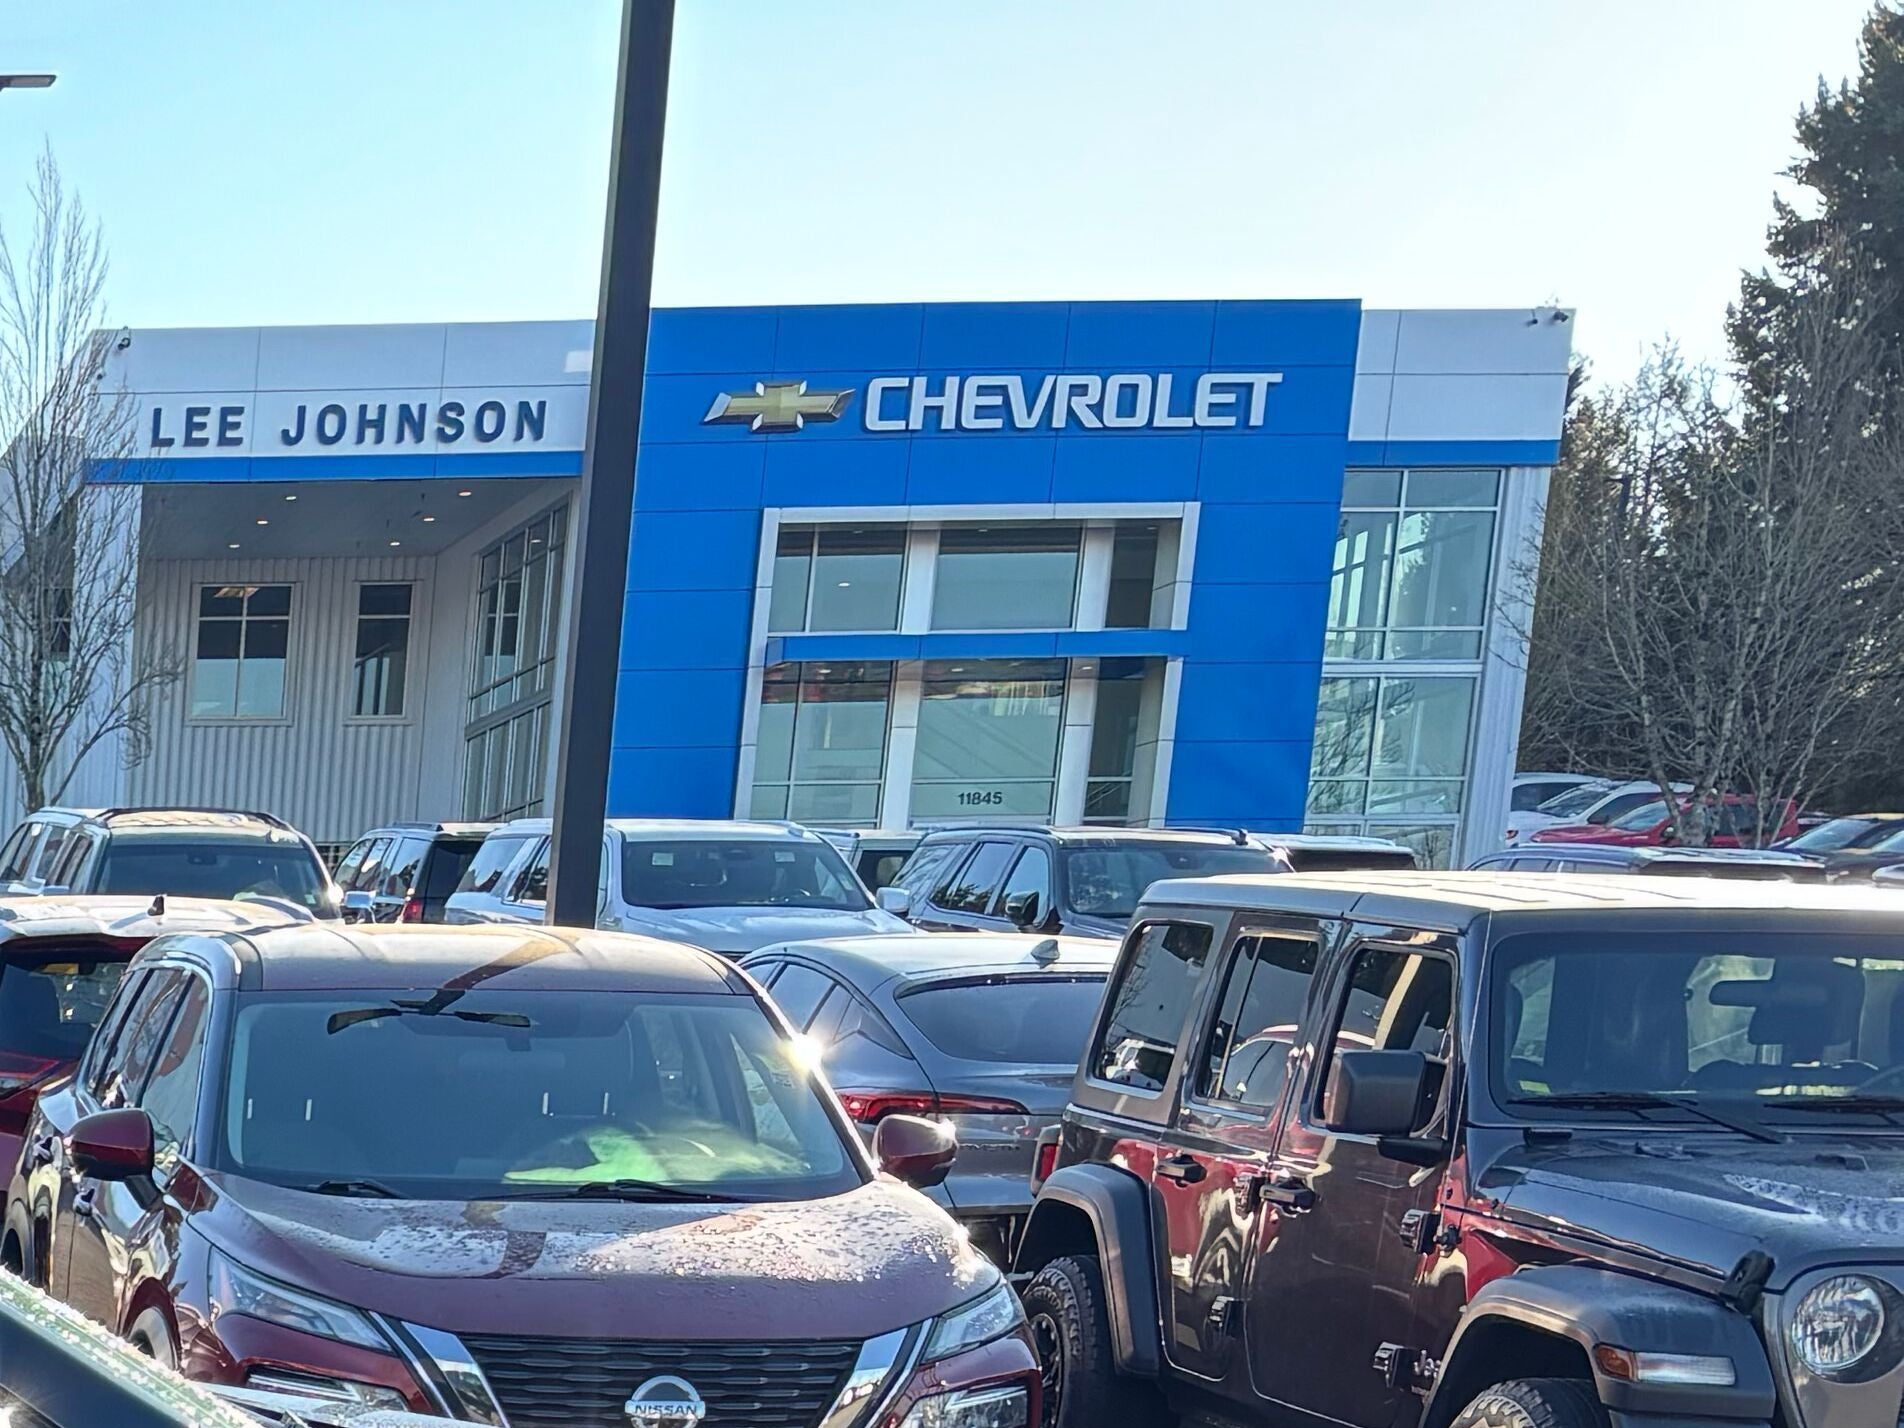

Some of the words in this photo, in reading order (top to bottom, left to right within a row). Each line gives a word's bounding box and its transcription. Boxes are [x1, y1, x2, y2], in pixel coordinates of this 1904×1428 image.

[864, 372, 1283, 431] CHEVROLET
[150, 405, 246, 448] LEE
[281, 400, 548, 447] JOHNSON
[957, 790, 1003, 807] 11845
[634, 1404, 697, 1416] NISSAN
